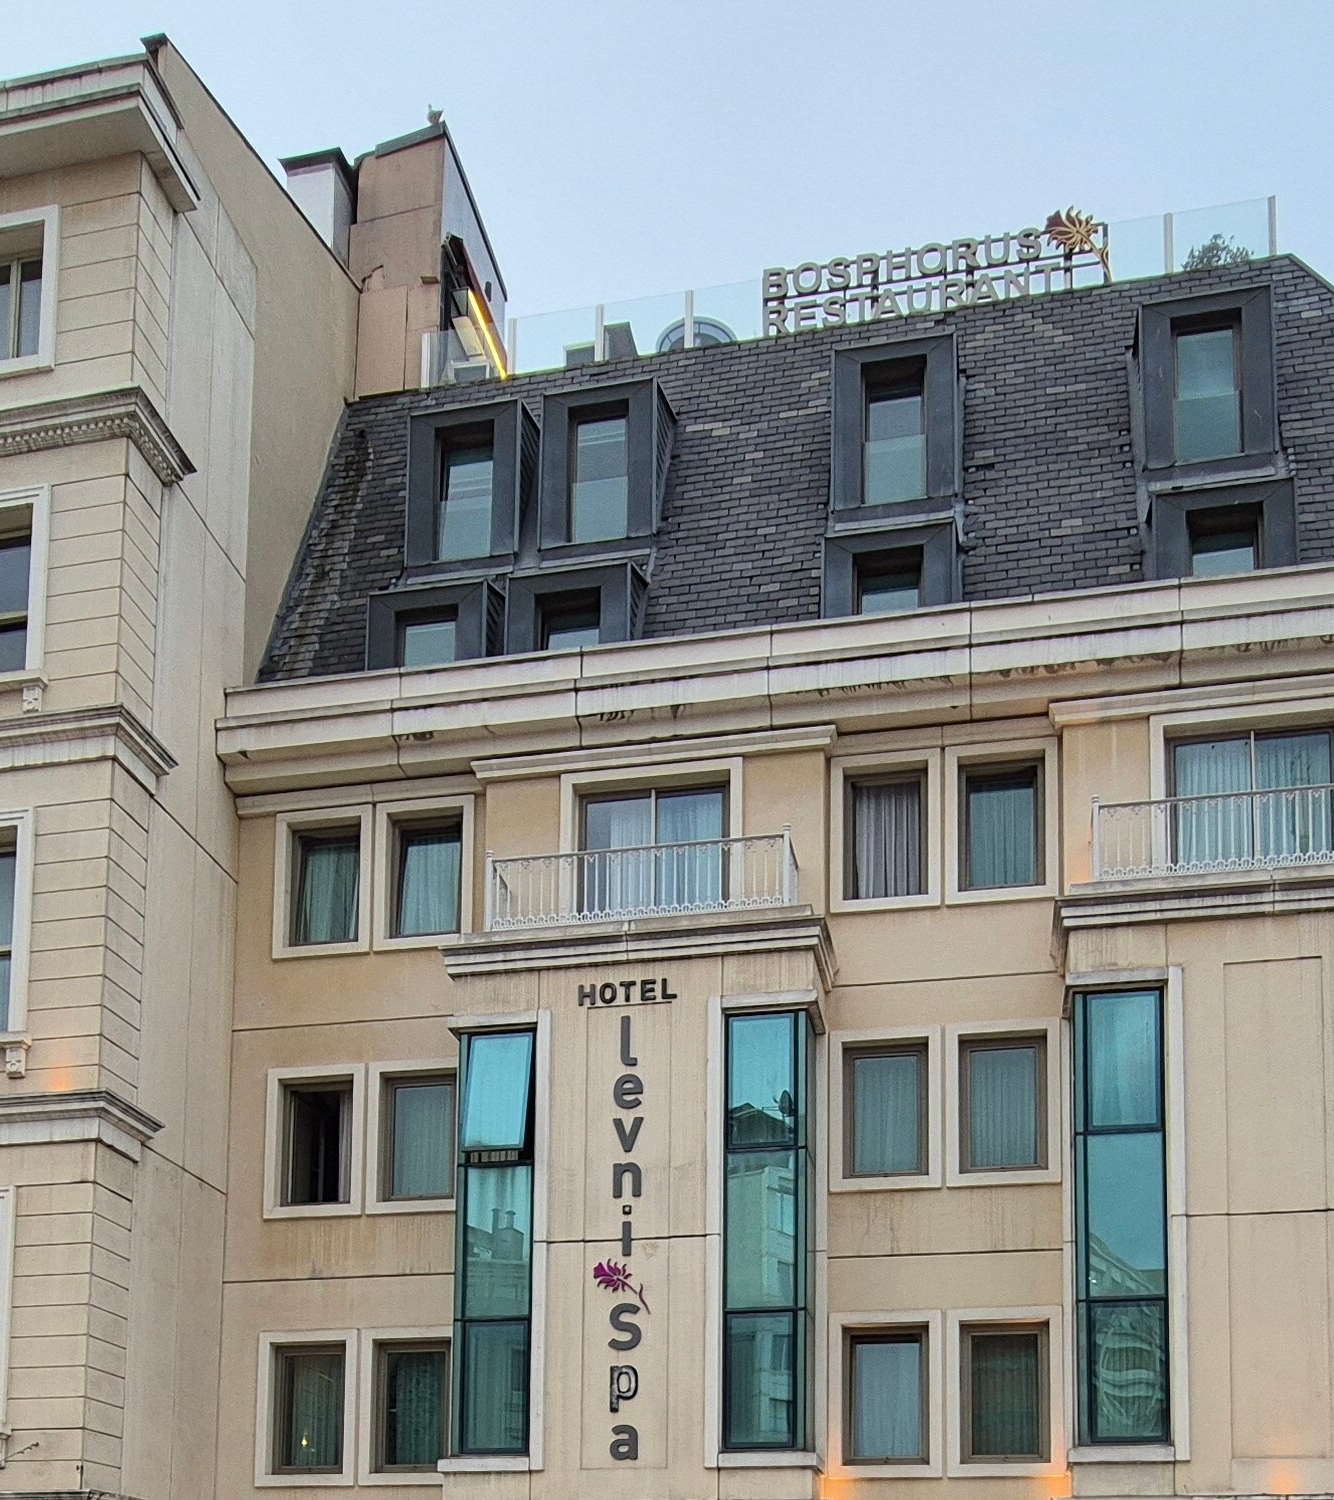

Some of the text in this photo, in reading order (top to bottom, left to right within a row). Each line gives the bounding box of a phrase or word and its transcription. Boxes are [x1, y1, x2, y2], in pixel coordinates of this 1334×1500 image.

[762, 227, 1043, 299] BOSPHORUS
[763, 262, 1061, 336] RESTAURANT
[578, 978, 677, 1006] HOTEL
[612, 1015, 644, 1257] levni
